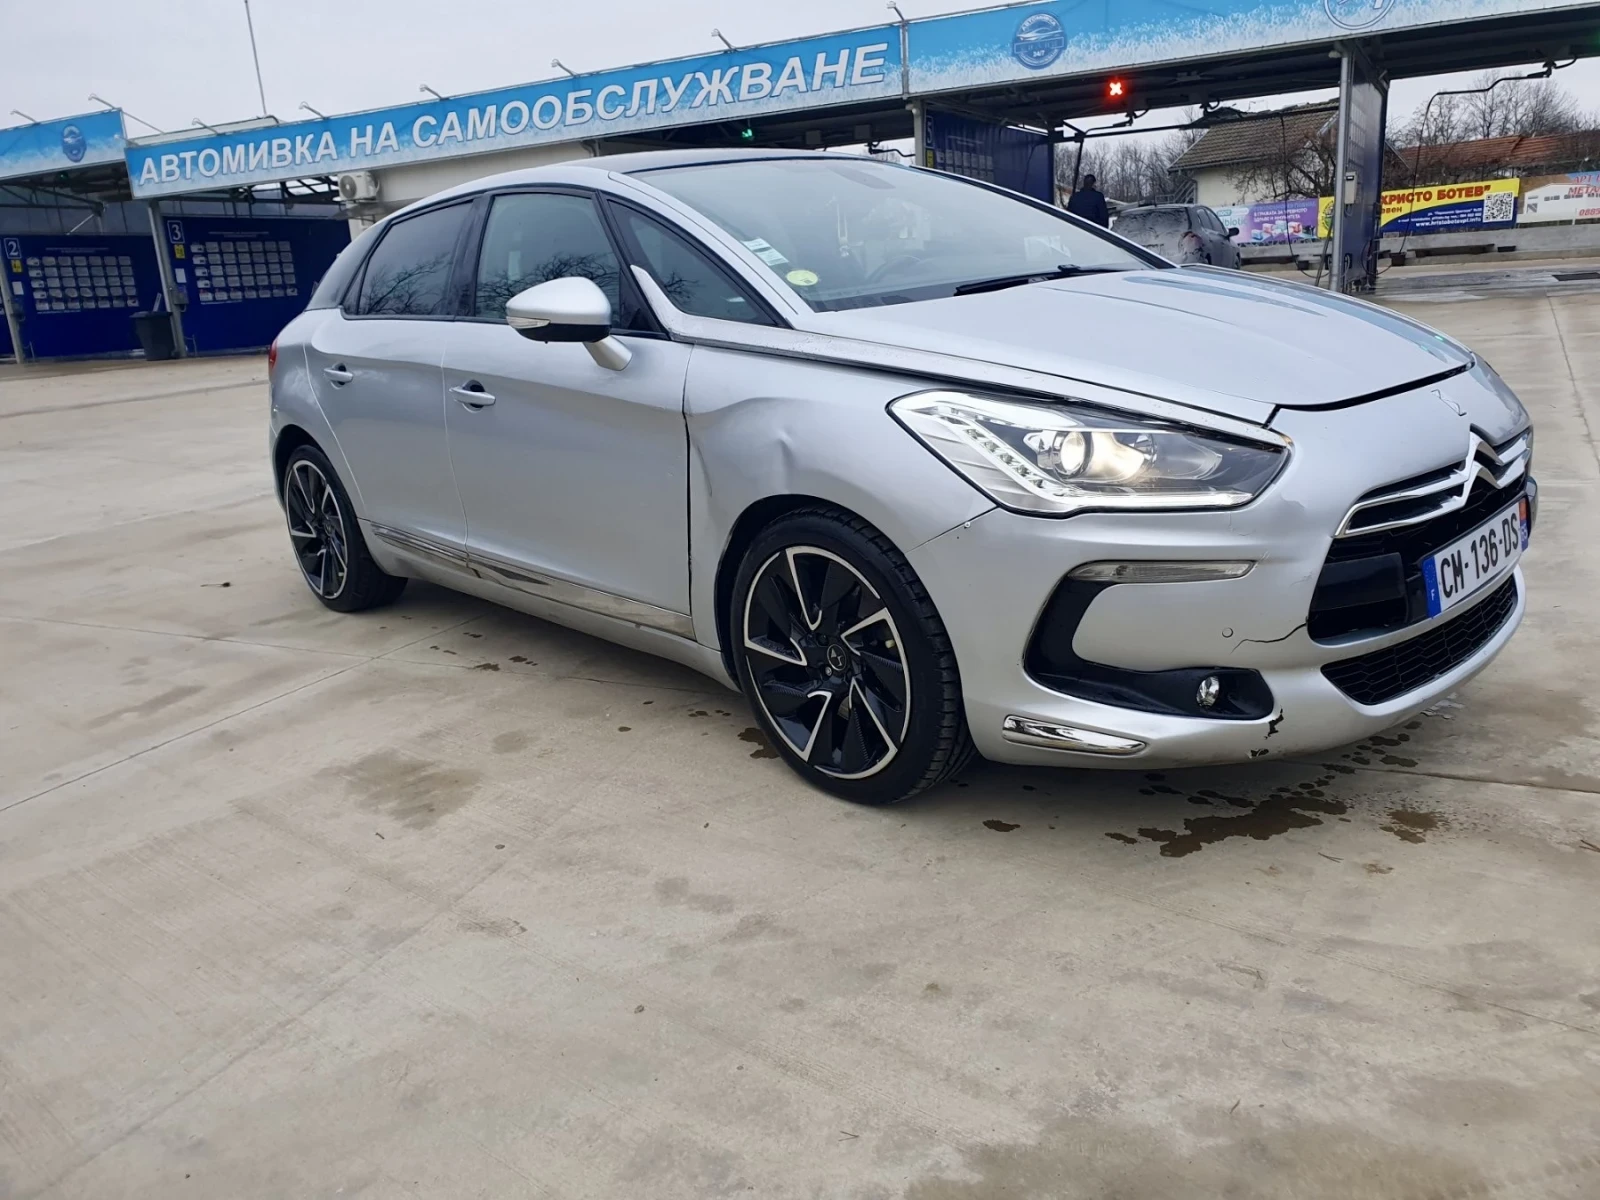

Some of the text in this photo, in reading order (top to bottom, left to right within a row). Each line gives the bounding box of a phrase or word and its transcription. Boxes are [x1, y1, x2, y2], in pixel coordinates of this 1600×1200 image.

[139, 130, 338, 186] АВТОМИВКА
[349, 121, 400, 159] НА
[411, 41, 889, 149] САМООБСЛУЖВАНЕ
[8, 241, 19, 256] 2
[172, 224, 182, 241] 3
[1440, 512, 1519, 599] CM-136-DS
